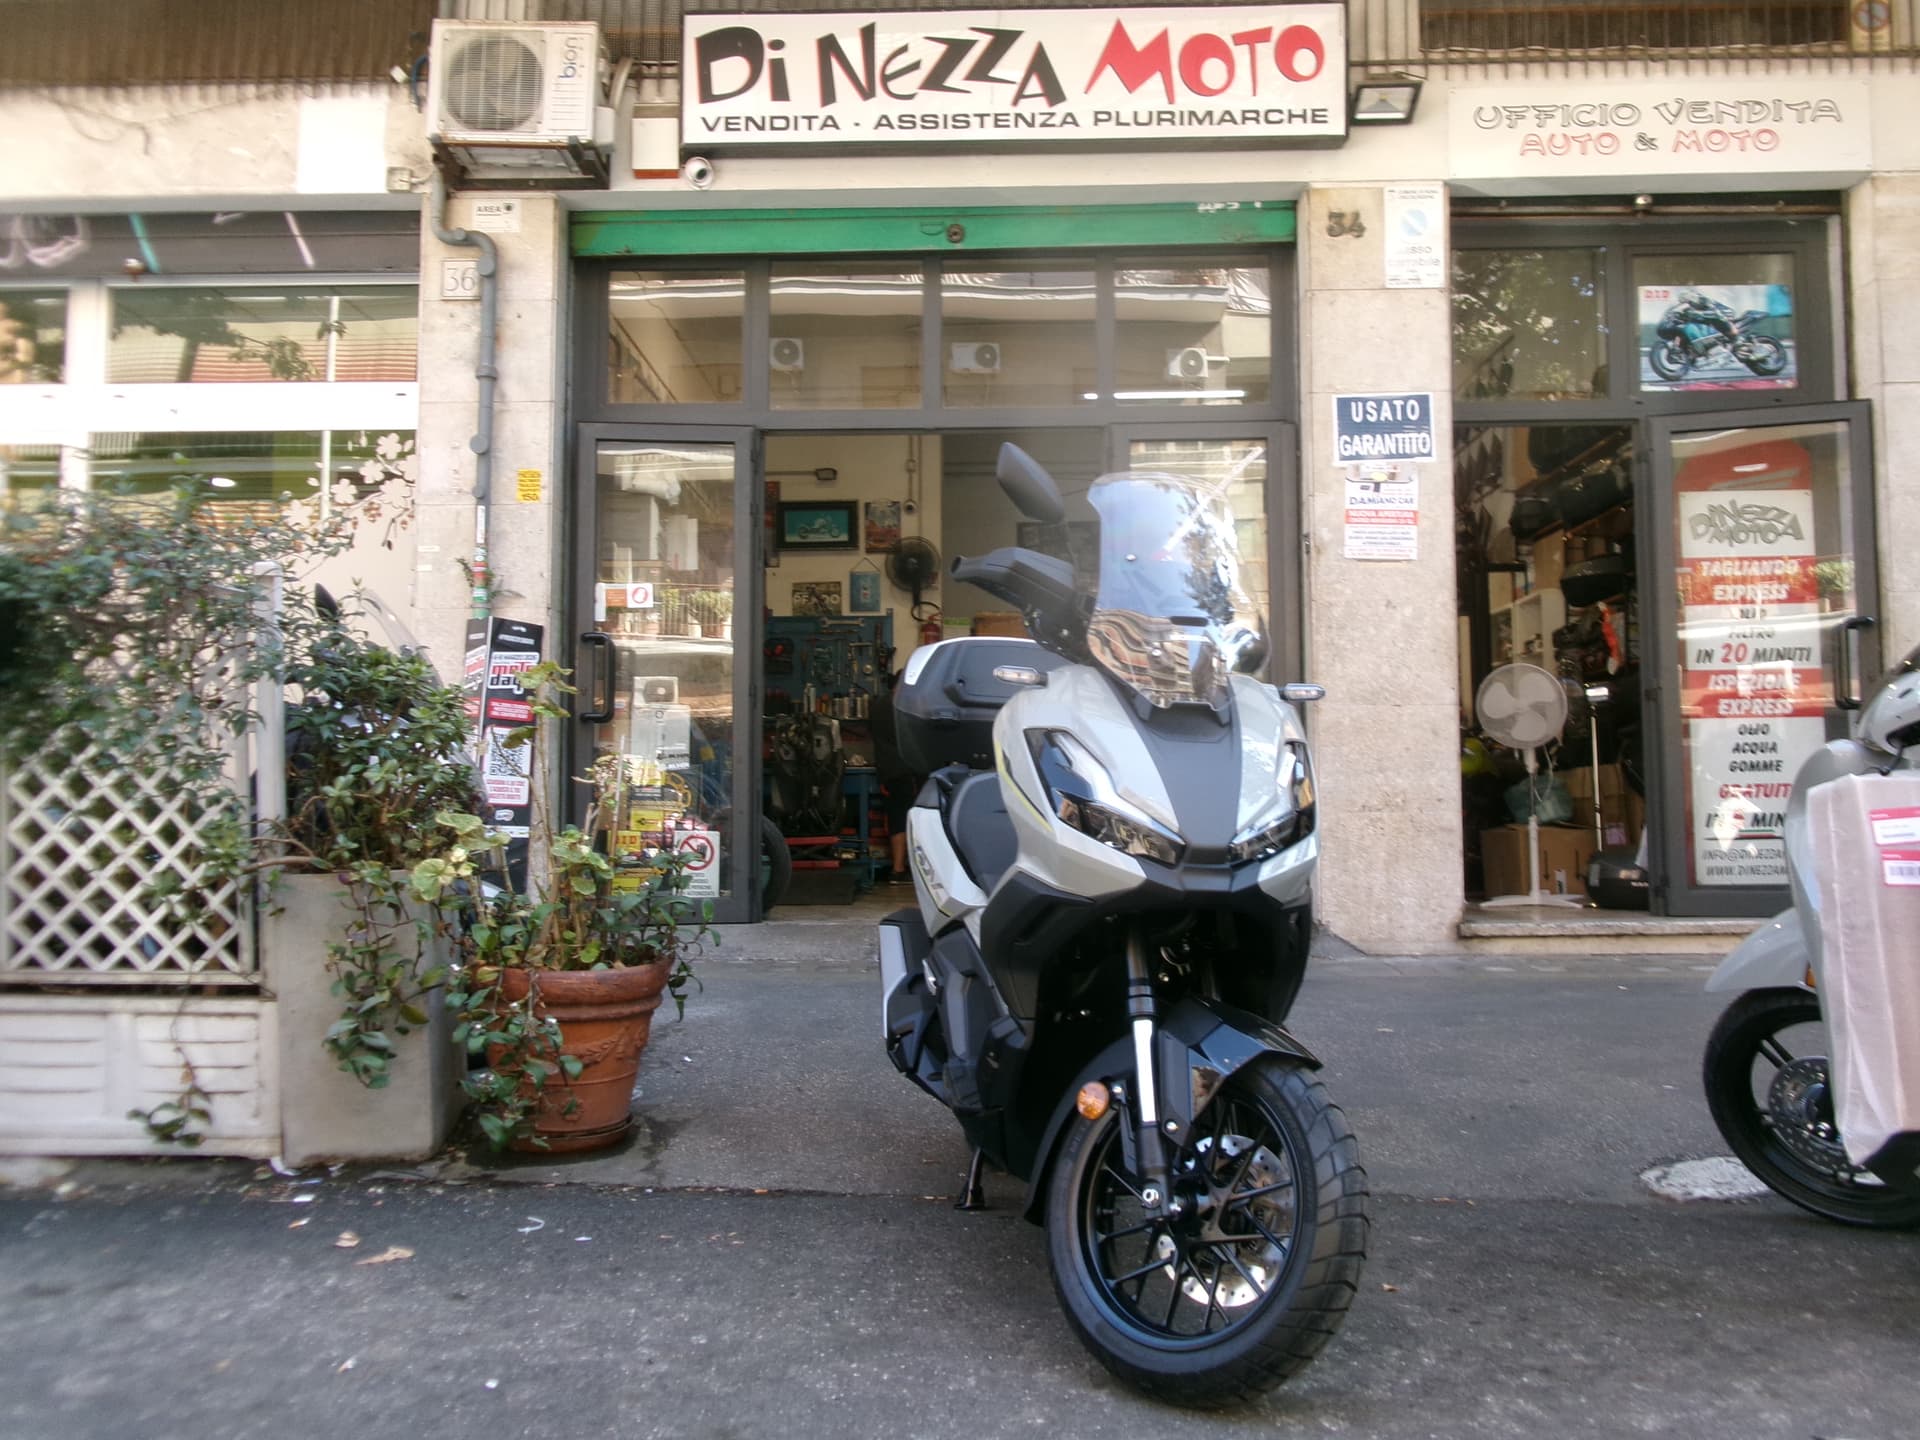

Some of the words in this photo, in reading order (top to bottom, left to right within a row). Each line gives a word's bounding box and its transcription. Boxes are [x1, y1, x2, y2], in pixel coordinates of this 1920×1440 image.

[1084, 18, 1325, 106] MOTO
[701, 114, 840, 133] VENDITA
[874, 111, 1080, 131] ASSISTENZA
[1093, 108, 1329, 129] PLURIMARCHE
[1473, 103, 1641, 129] UFFICIO
[1653, 98, 1843, 124] VENDITA
[1519, 132, 1620, 156] AUTO
[1634, 132, 1658, 151] &
[1672, 128, 1780, 153] MOTO
[447, 267, 476, 293] 36
[1351, 399, 1420, 422] USATO
[1339, 432, 1431, 457] GARANTITO
[1700, 559, 1799, 577] TAGLIANDO
[1712, 583, 1791, 601] EXPRESS
[1696, 648, 1714, 664] IN
[1720, 642, 1748, 664] 20
[1752, 647, 1812, 662] MINUTI
[1718, 698, 1794, 715] EXPRESS
[1732, 742, 1778, 754] ACQUA
[1729, 760, 1784, 772] GOMME
[1719, 783, 1793, 799] GRATUIT
[1751, 813, 1786, 828] MIN
